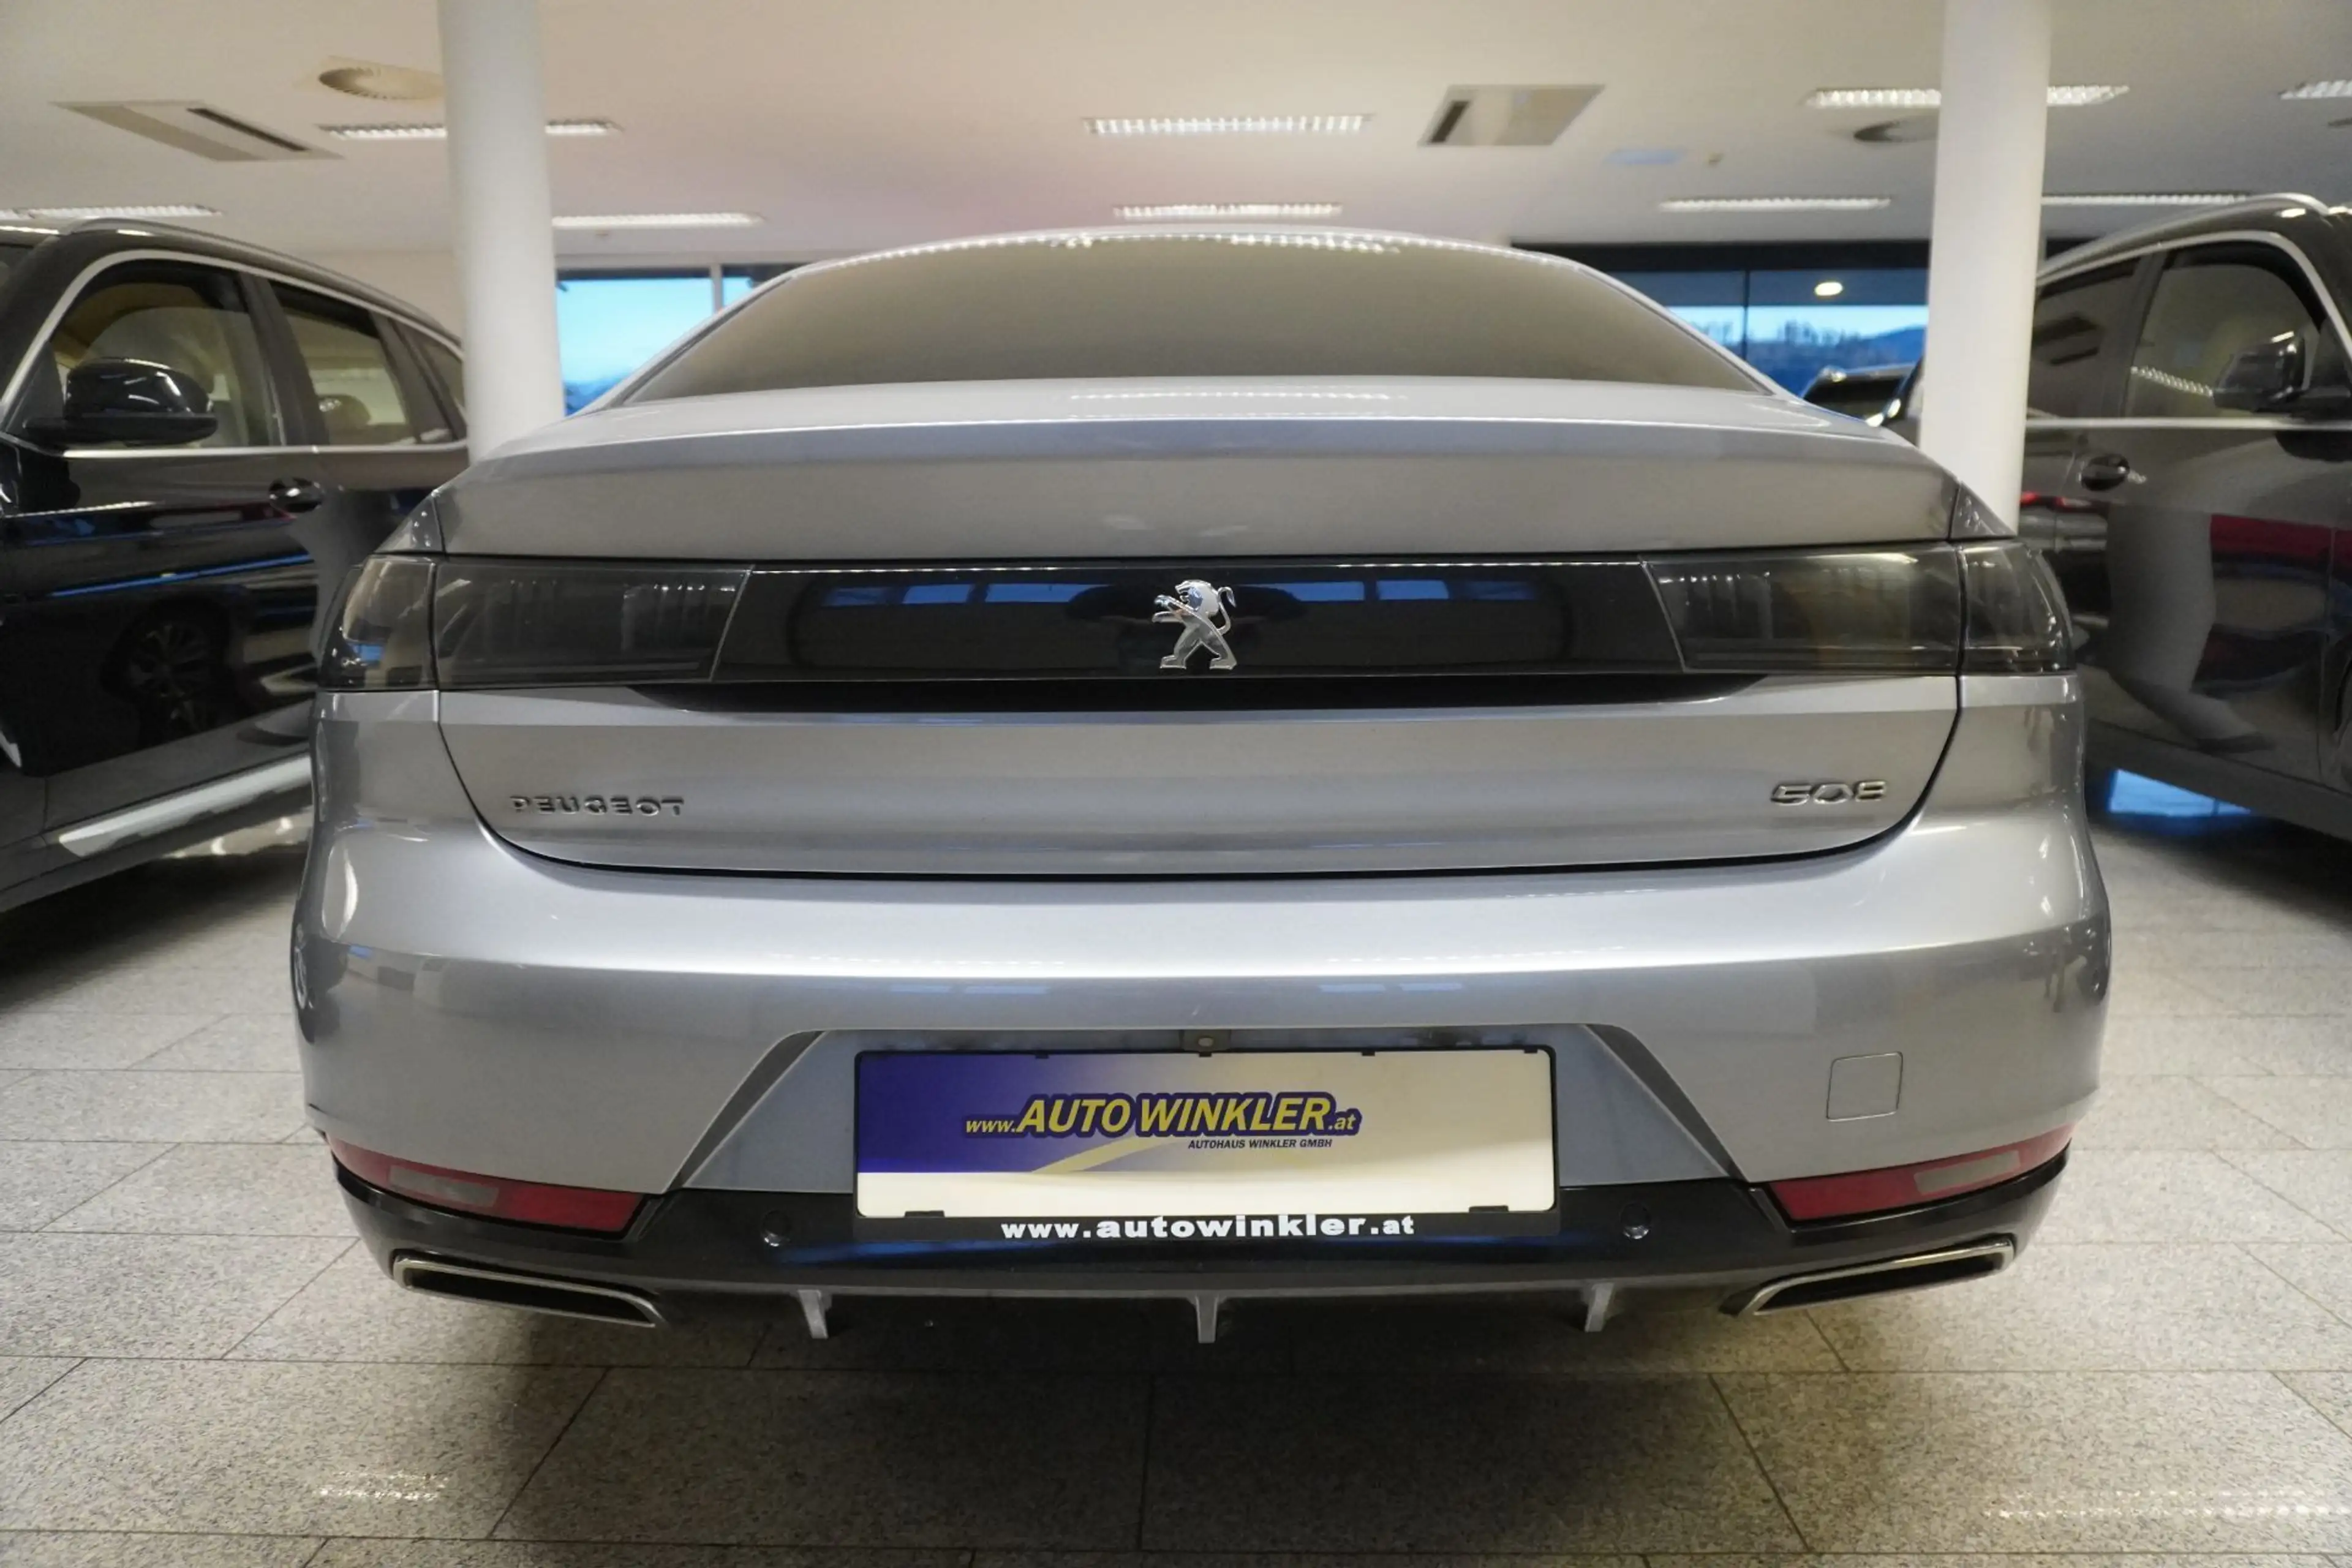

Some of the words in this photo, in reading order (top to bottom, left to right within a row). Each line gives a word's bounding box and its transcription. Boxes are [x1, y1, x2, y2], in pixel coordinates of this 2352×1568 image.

[1772, 781, 1887, 806] 508
[509, 796, 684, 816] PEUGEOT
[1188, 1139, 1246, 1149] AUTOHAUS
[1249, 1139, 1296, 1148] WINKLER
[1300, 1139, 1333, 1148] GMBH
[1001, 1214, 1415, 1238] www.autowinkler.at
